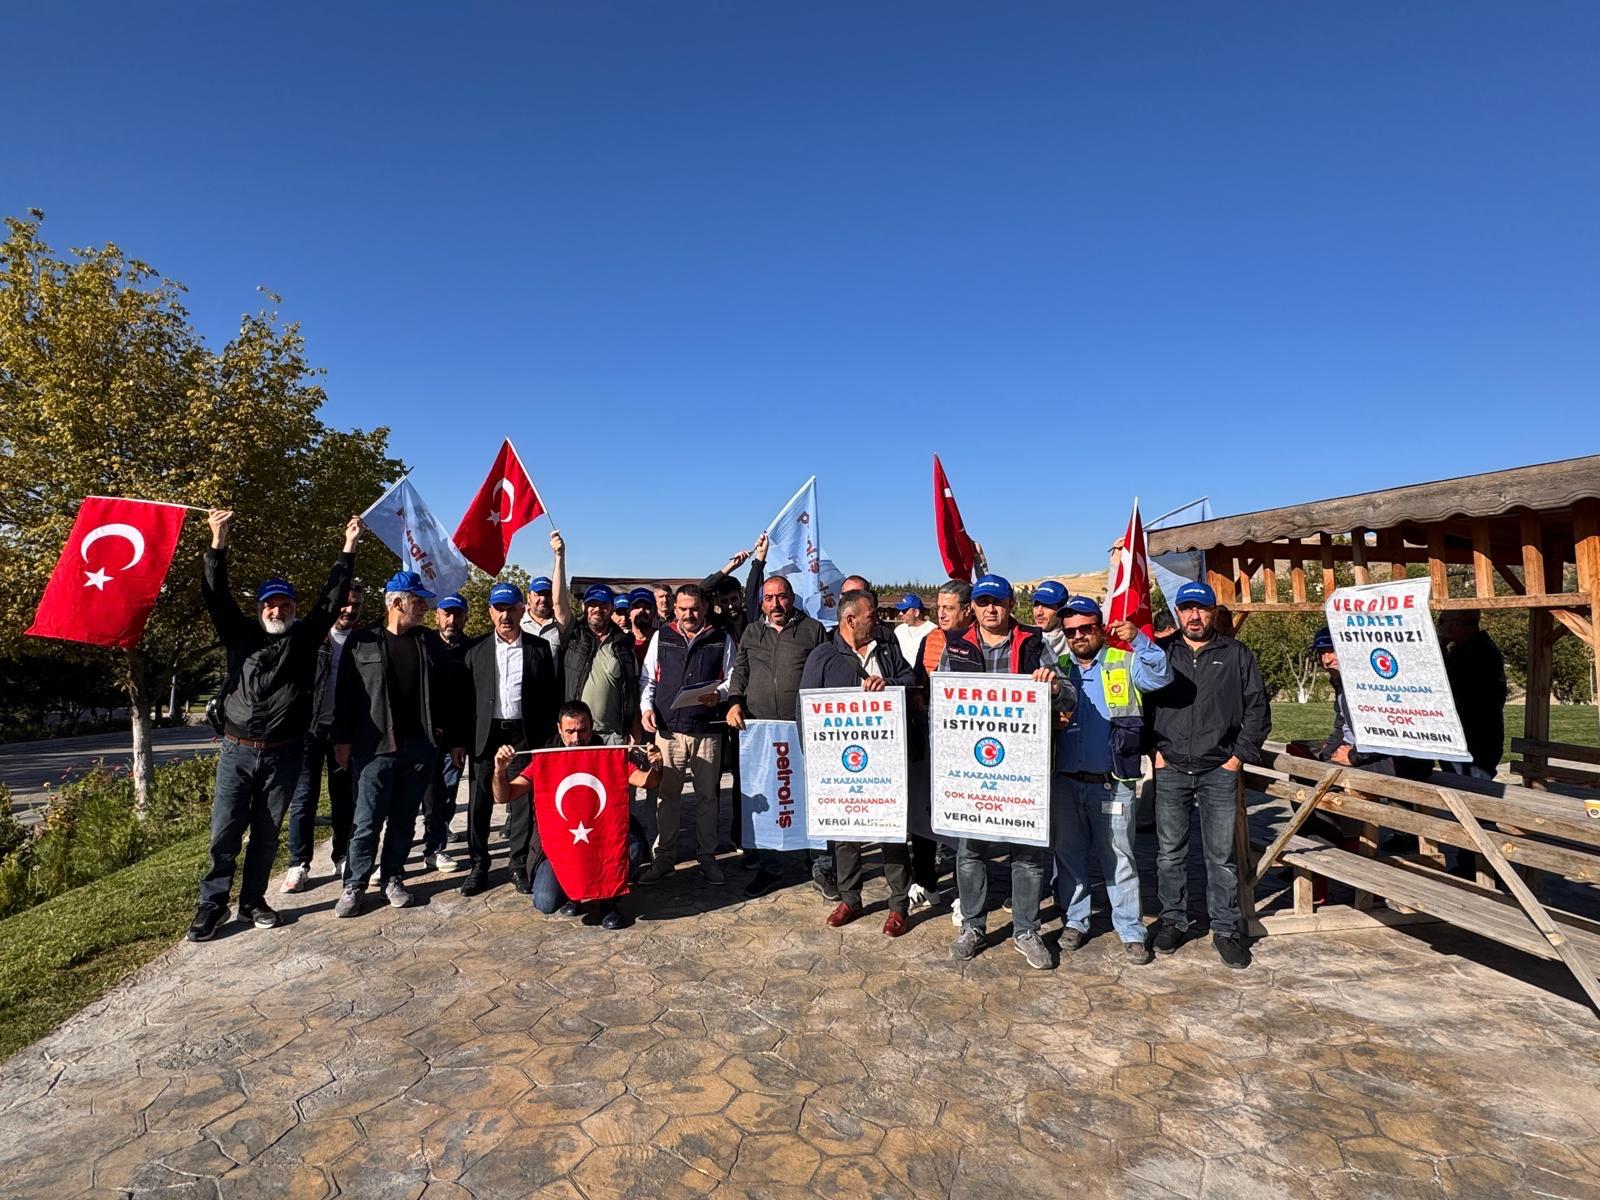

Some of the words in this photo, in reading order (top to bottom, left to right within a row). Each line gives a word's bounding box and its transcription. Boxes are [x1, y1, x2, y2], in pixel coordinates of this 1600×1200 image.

[1333, 595, 1415, 612] VERGİDE
[1346, 614, 1403, 627] ADALET
[1356, 682, 1367, 690] AZ
[1367, 683, 1433, 694] KAZANANDAN
[943, 687, 1037, 703] VERGİDE
[1386, 693, 1402, 703] AZ
[812, 699, 893, 714] VERGİDE
[955, 704, 1025, 719] ADALET
[1357, 704, 1377, 713] ÇOK
[1377, 706, 1444, 717] KAZANANDAN
[823, 715, 883, 728] ADALET
[1387, 715, 1415, 726] ÇOK
[1364, 726, 1399, 738] VERGİ
[1402, 730, 1452, 742] ALINSIN
[820, 777, 832, 785] AZ
[833, 777, 892, 785] KAZANANDAN
[948, 770, 961, 778] AZ
[963, 770, 1031, 783] KAZANANDAN
[772, 741, 795, 829] petrol-iş
[848, 785, 864, 793] AZ
[980, 780, 998, 791] AZ
[817, 797, 836, 805] ÇOK
[838, 797, 897, 805] KAZANANDAN
[944, 790, 966, 799] ÇOK
[967, 793, 1035, 805] KAZANANDAN
[844, 805, 870, 815] ÇOK
[974, 801, 1004, 812] ÇOK
[817, 817, 851, 826] VERGİ
[944, 811, 981, 823] VERGİ
[985, 816, 1035, 828] ALINSIN
